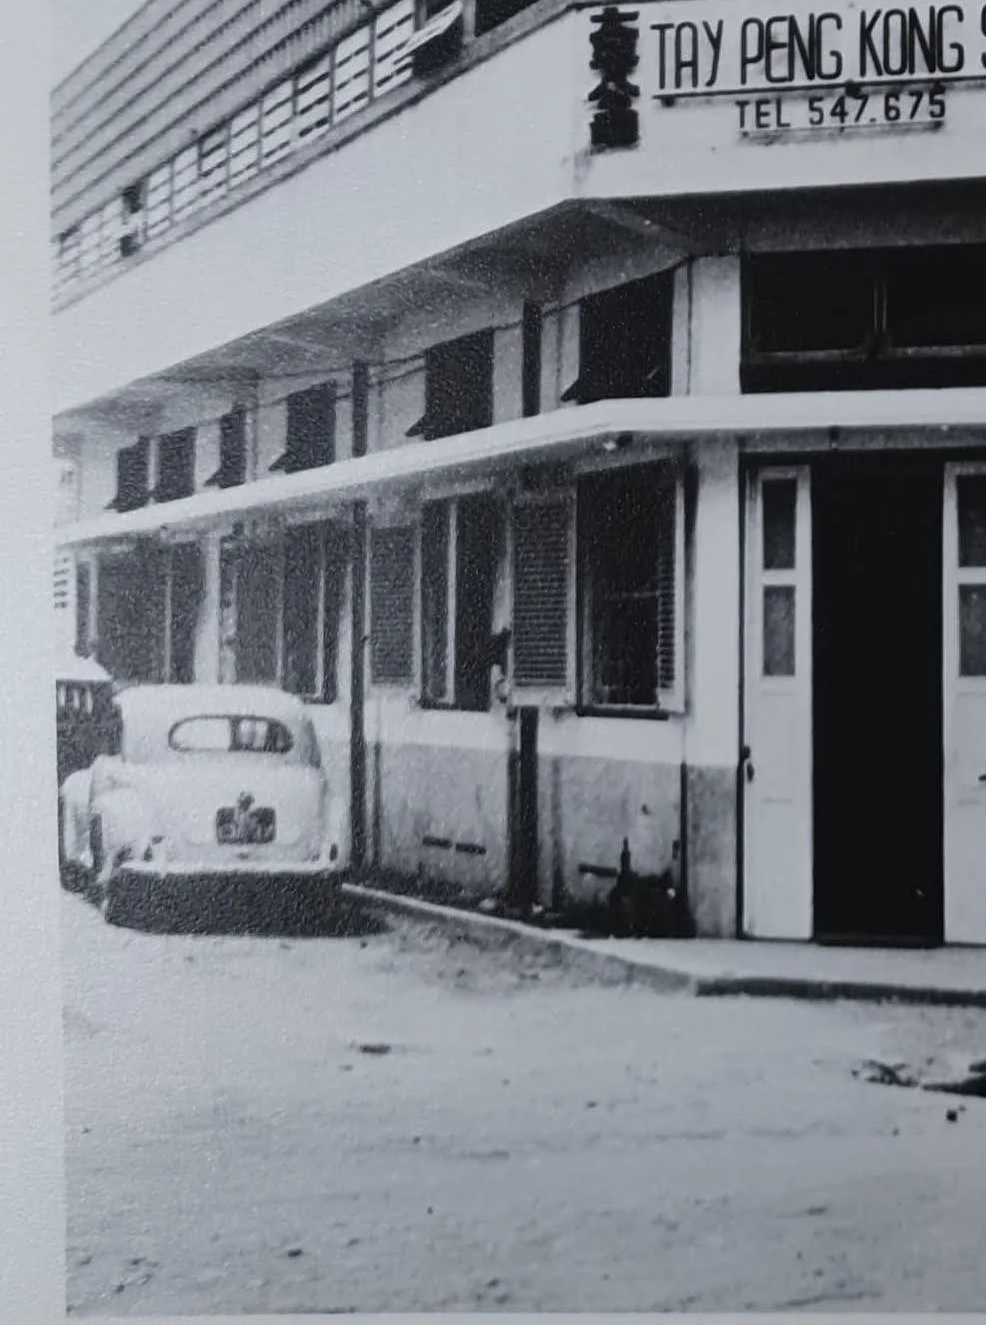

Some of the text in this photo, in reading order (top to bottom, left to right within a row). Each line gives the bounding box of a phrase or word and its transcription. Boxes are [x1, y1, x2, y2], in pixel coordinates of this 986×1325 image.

[650, 18, 724, 90] TAY
[739, 11, 843, 86] PENG
[859, 4, 965, 77] KONG
[734, 91, 947, 130] TEL 547.675
